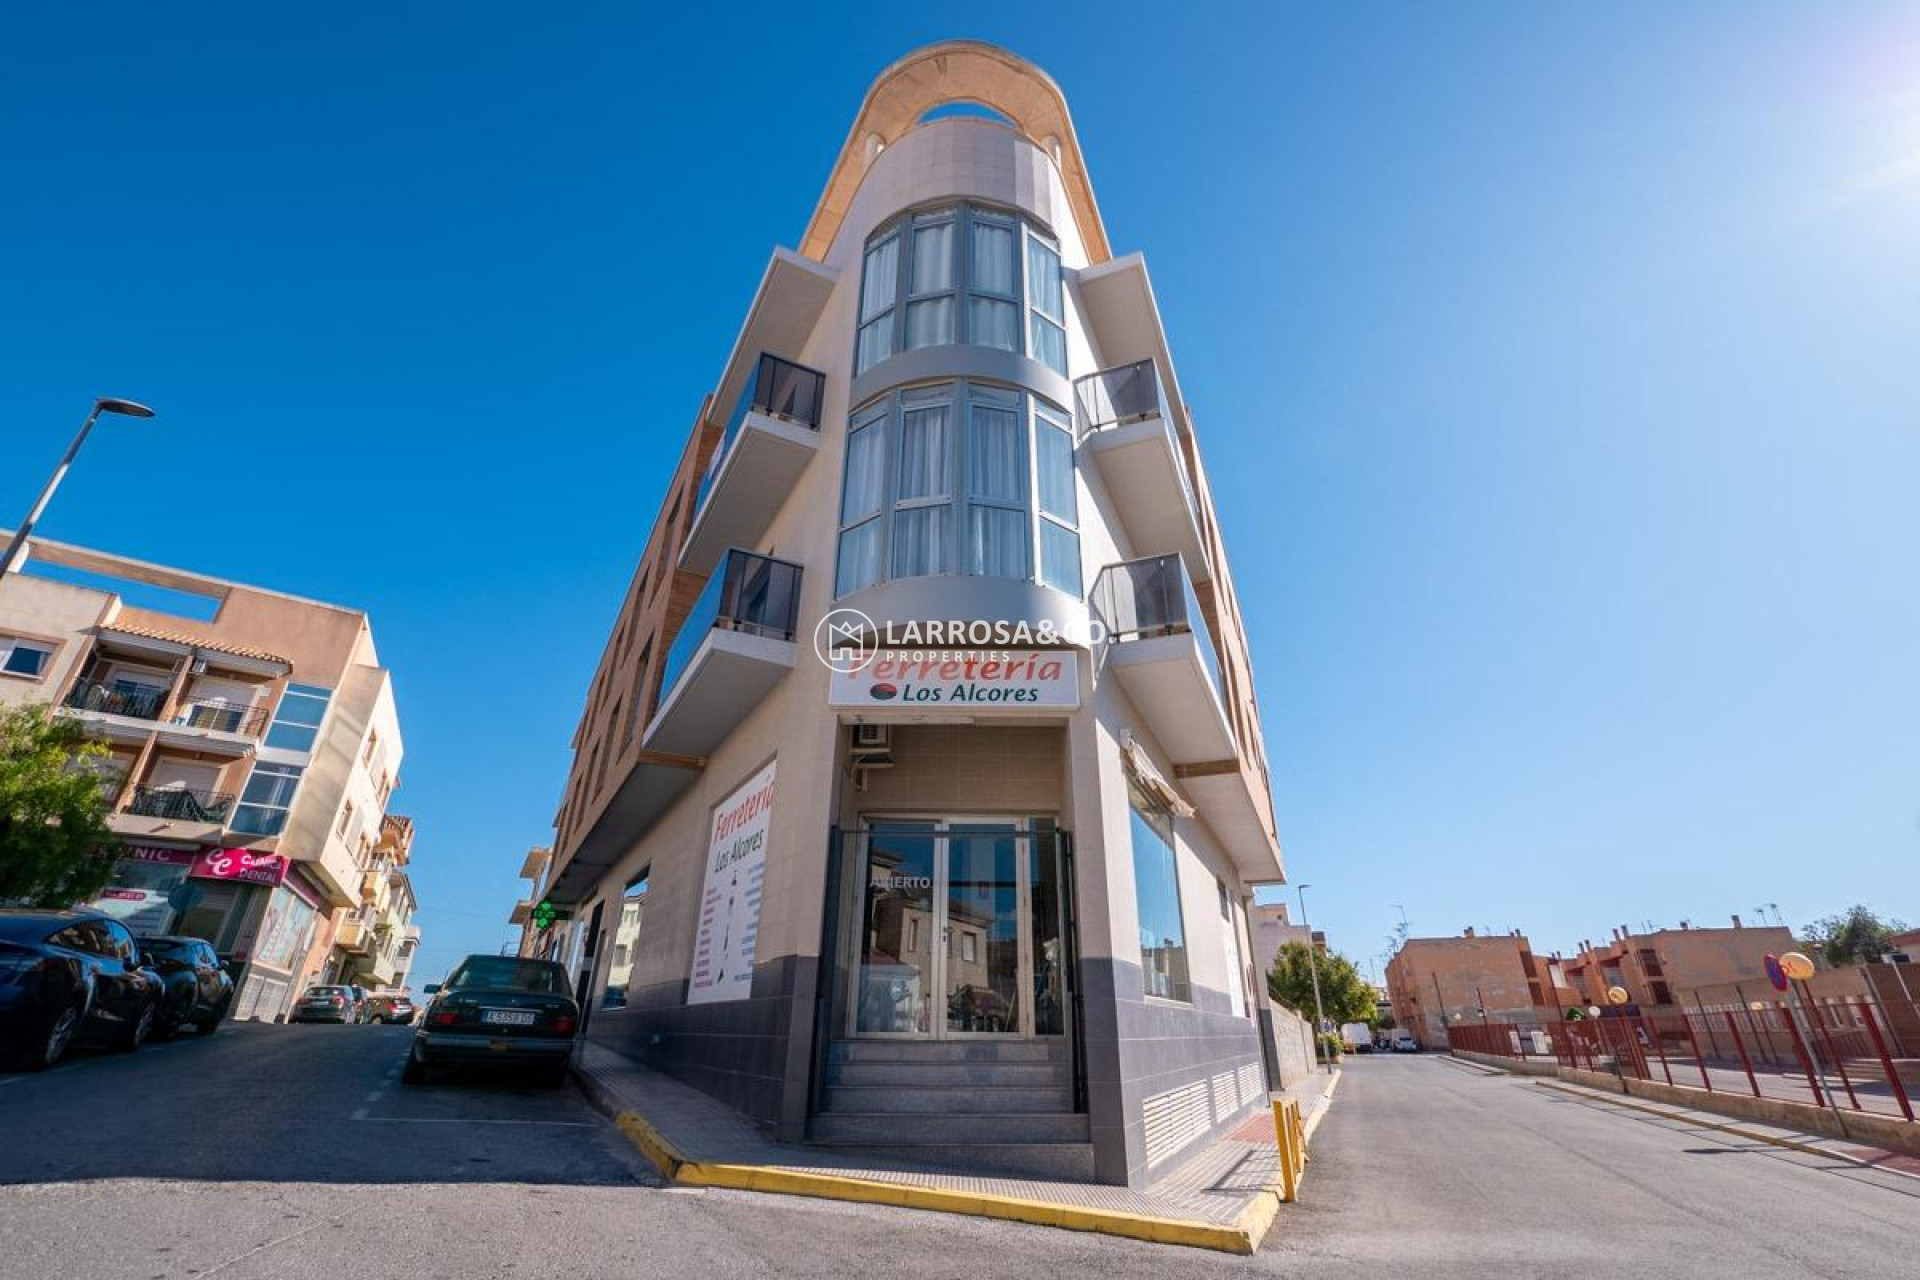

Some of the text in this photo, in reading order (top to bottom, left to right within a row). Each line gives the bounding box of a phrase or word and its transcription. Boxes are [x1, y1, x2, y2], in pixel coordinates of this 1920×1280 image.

[848, 653, 1063, 681] Ferretería
[903, 684, 1039, 702] Los Alcores
[714, 828, 764, 873] Los Alcores
